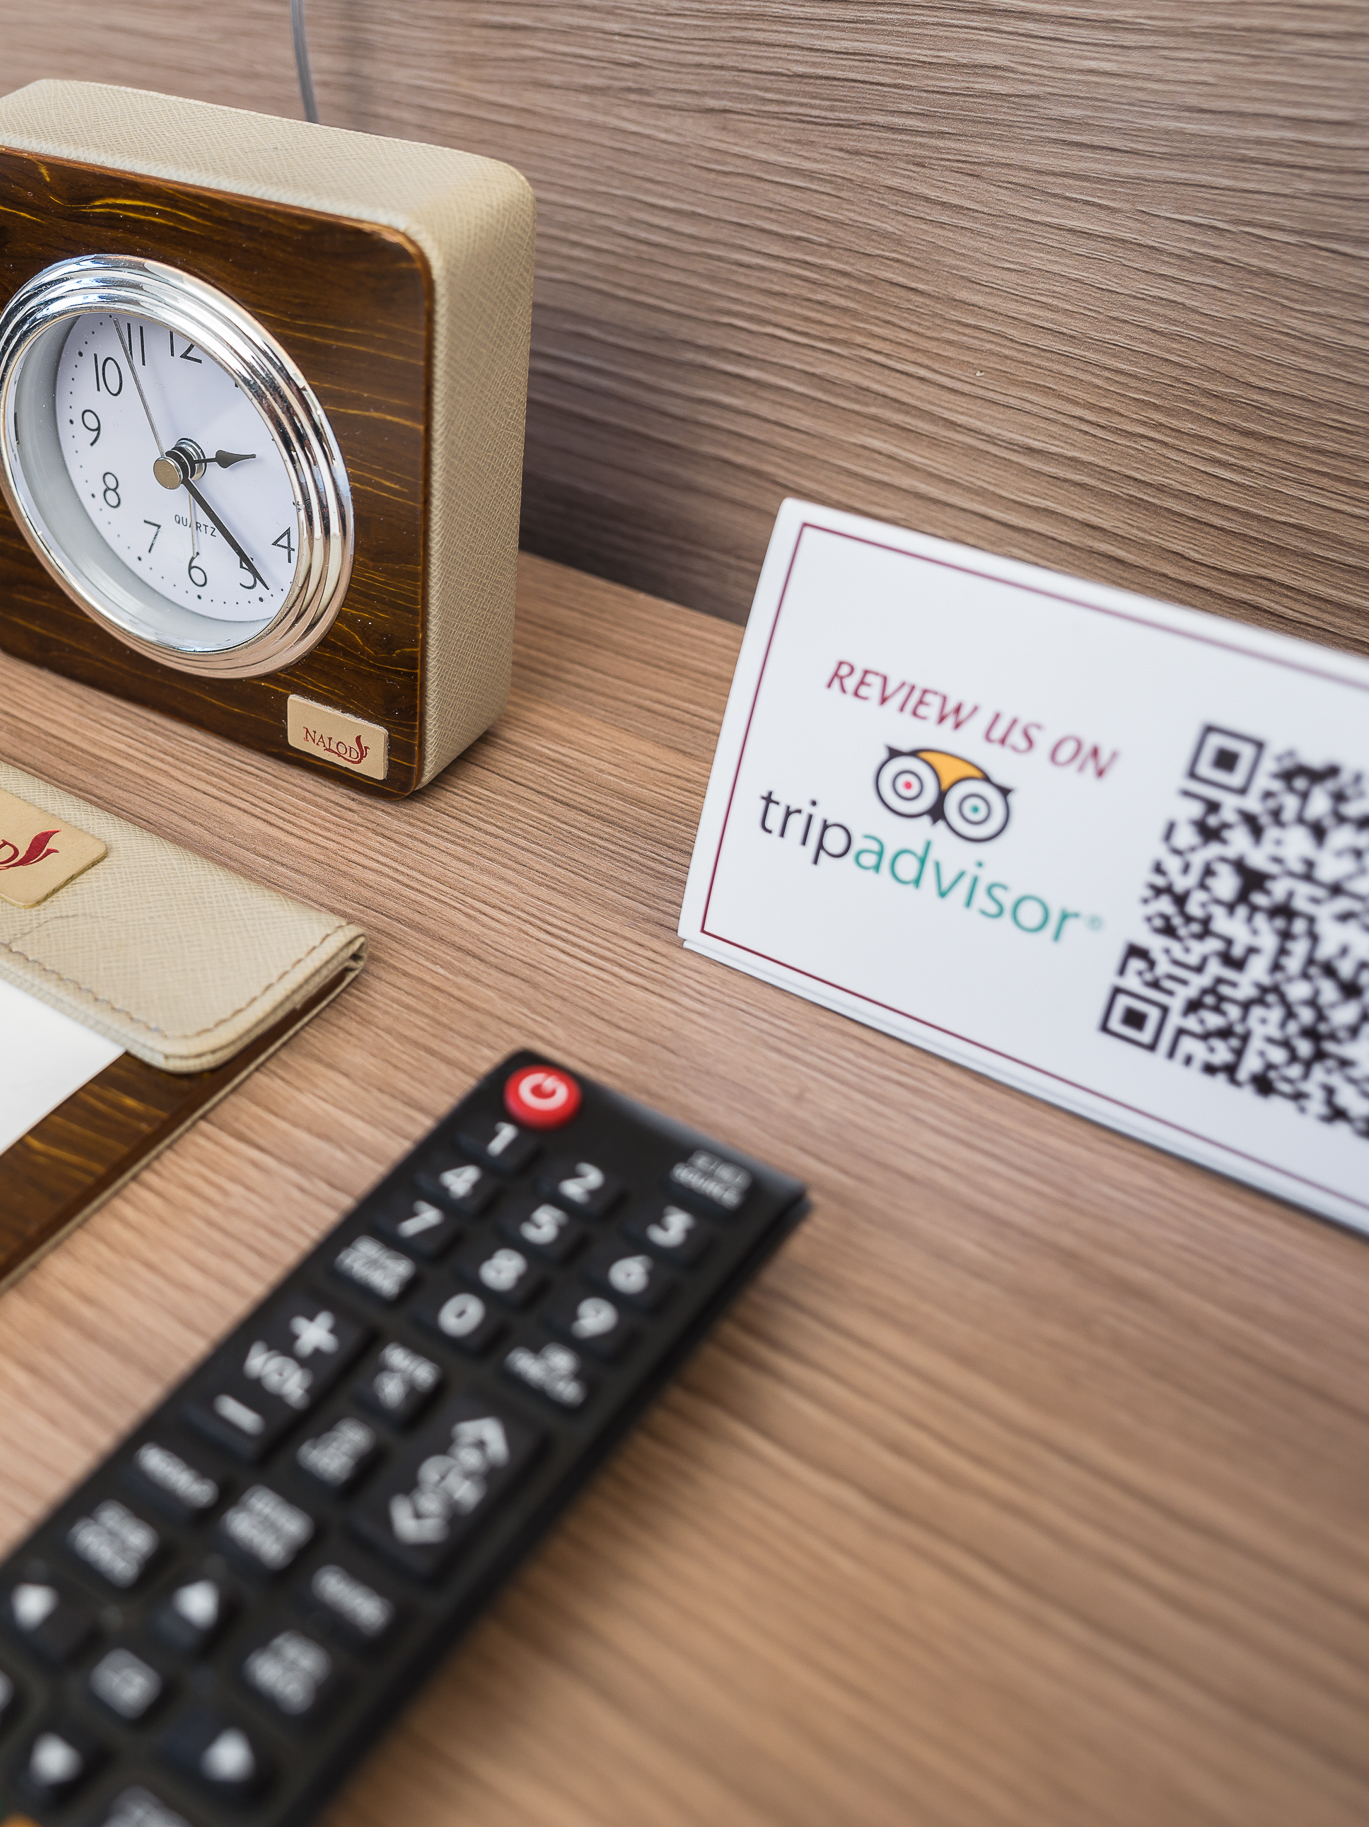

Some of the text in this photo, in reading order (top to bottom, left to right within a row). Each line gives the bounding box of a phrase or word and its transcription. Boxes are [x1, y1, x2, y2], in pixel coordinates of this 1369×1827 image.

[94, 353, 123, 397] 10
[81, 409, 101, 447] 9
[102, 472, 121, 509] 8
[143, 519, 161, 554] 7
[271, 527, 296, 564] 4
[188, 551, 207, 587] 6
[826, 660, 1120, 780] REVIEW US ON
[303, 726, 367, 763] NALOD
[486, 1120, 518, 1157] 1
[439, 1163, 482, 1200] 4
[559, 1162, 605, 1203] 2
[396, 1200, 445, 1238] 7
[520, 1203, 568, 1245] 5
[646, 1204, 696, 1248] 3
[478, 1248, 528, 1292] 8
[608, 1253, 653, 1295] 6
[437, 1292, 486, 1338] 0
[571, 1296, 619, 1339] 9
